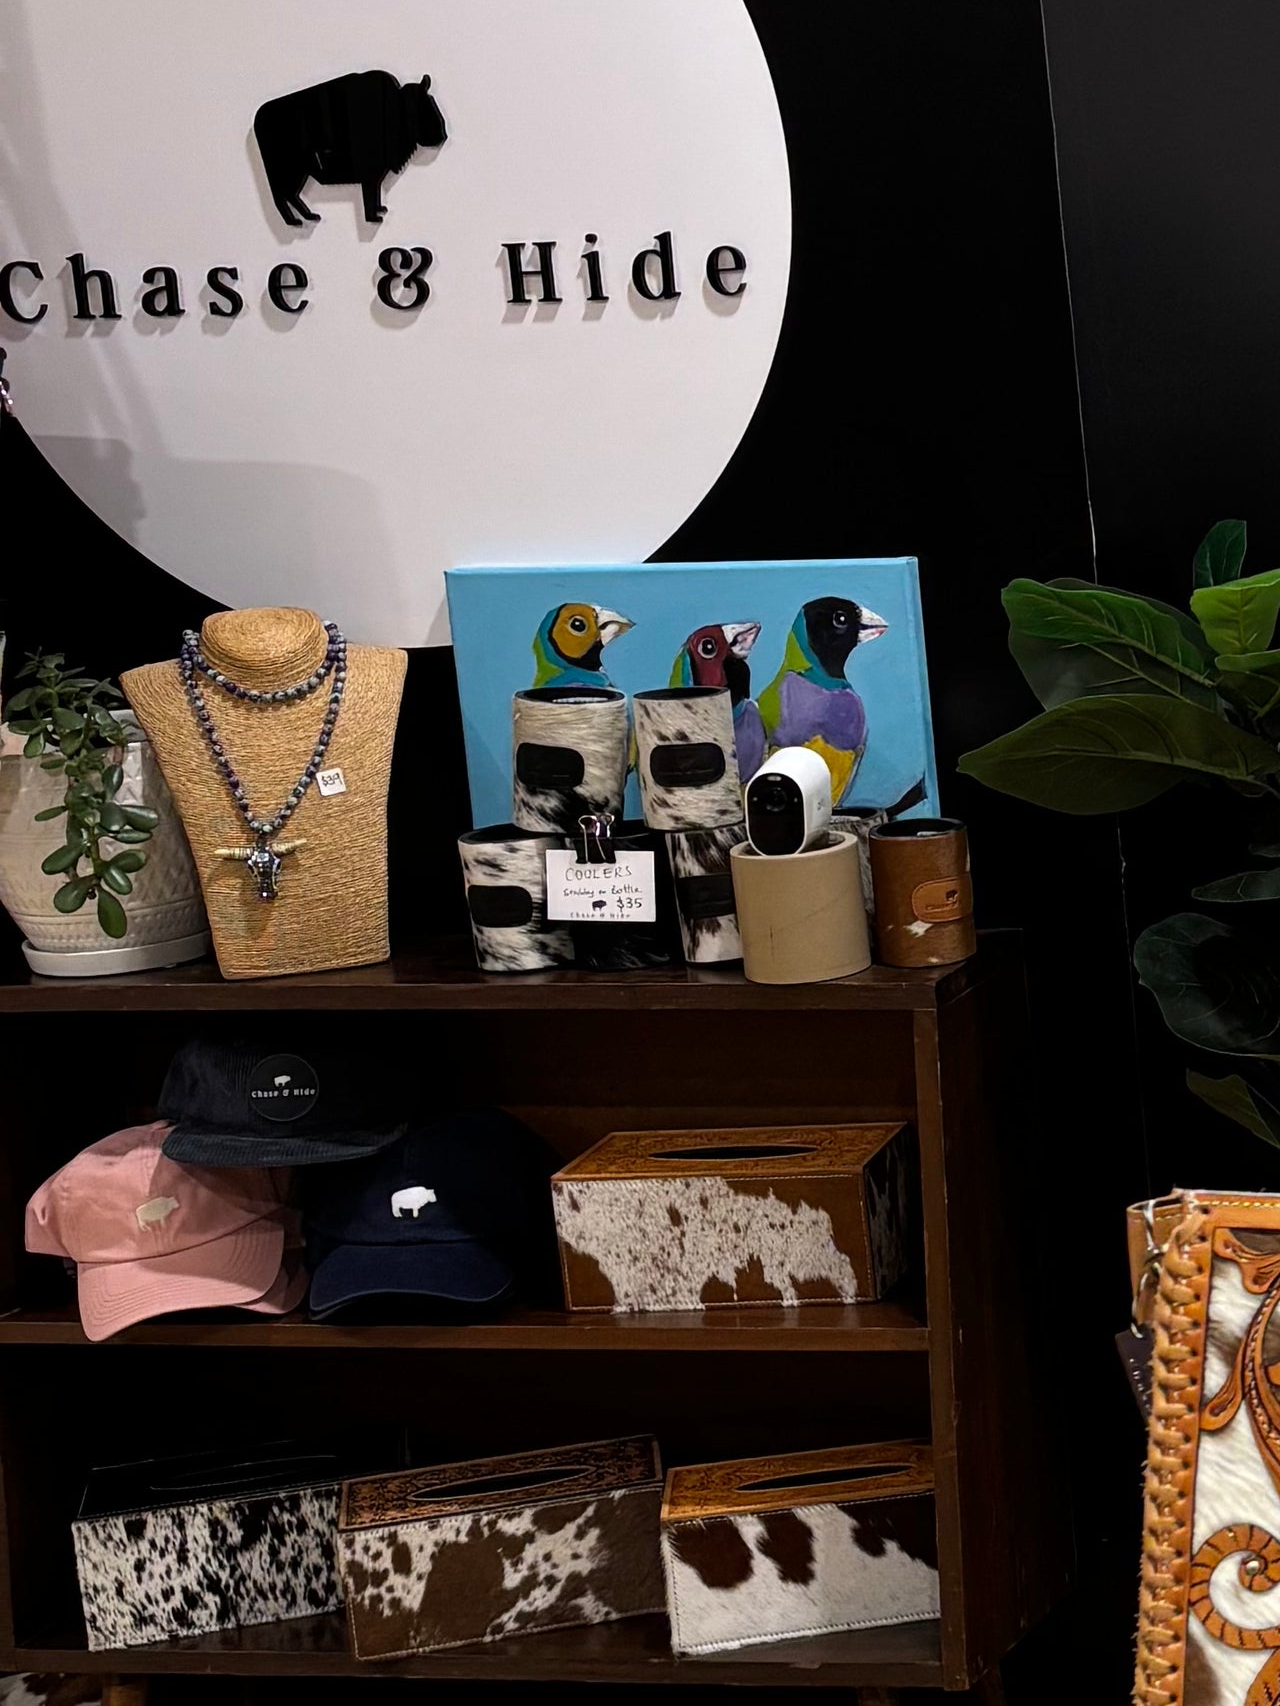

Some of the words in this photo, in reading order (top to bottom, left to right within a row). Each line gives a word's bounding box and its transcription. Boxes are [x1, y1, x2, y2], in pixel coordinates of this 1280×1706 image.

[0, 252, 310, 324] Chase
[376, 246, 433, 311] &
[501, 230, 748, 304] Hide
[321, 772, 342, 787] $39
[565, 865, 632, 881] COOLERS
[616, 896, 642, 913] $35
